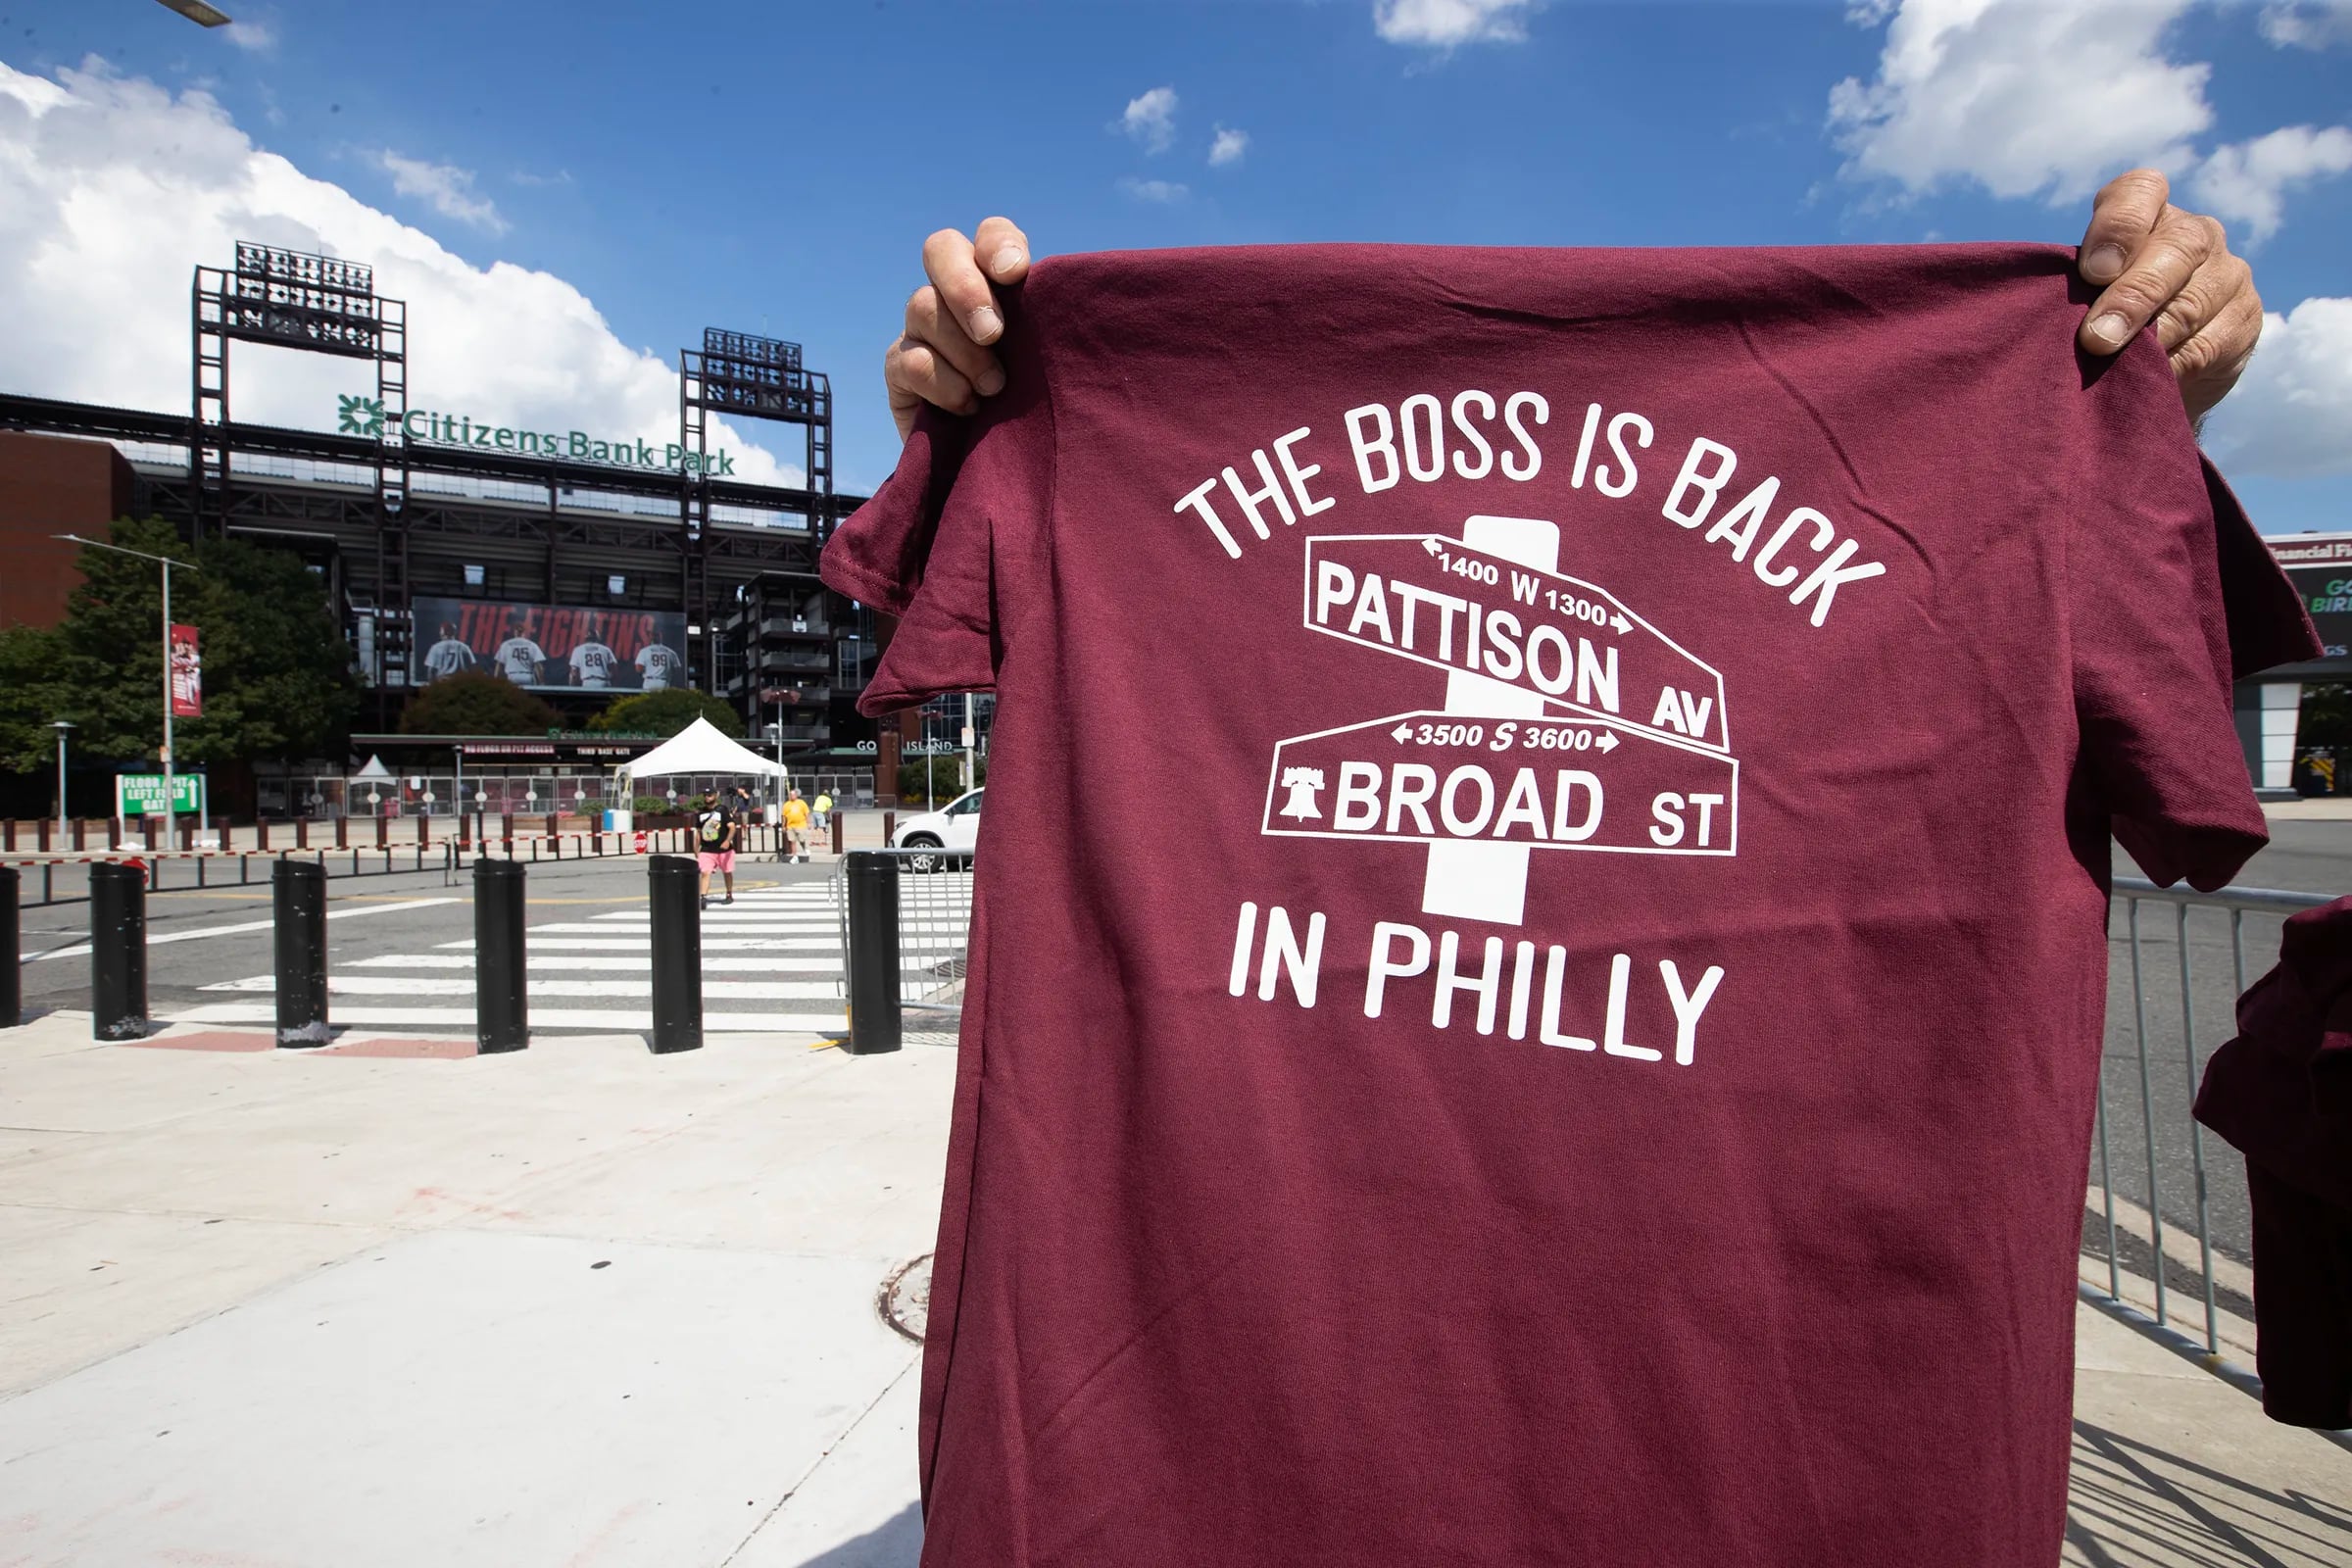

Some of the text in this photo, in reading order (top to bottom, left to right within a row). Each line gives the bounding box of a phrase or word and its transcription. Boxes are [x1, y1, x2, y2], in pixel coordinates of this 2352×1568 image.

[402, 410, 735, 475] Citizens Bank Park
[1174, 390, 1886, 627] THE BOSS IS BACK
[1439, 553, 1606, 626] 1400 W 1300
[2311, 597, 2352, 612] BIR
[458, 604, 516, 655] THE
[512, 647, 529, 661] 45
[584, 653, 602, 666] 28
[1317, 561, 1712, 737] PATTISON AV
[651, 654, 667, 667] 99
[906, 741, 953, 751] ISLAND
[1416, 722, 1592, 751] 3500 S 3600
[123, 777, 159, 788] FLOOR
[126, 788, 185, 800] LEFT FILD
[142, 800, 166, 810] GAT
[1334, 761, 1723, 846] BROAD ST
[1229, 902, 1724, 1065] IN PHILLY
